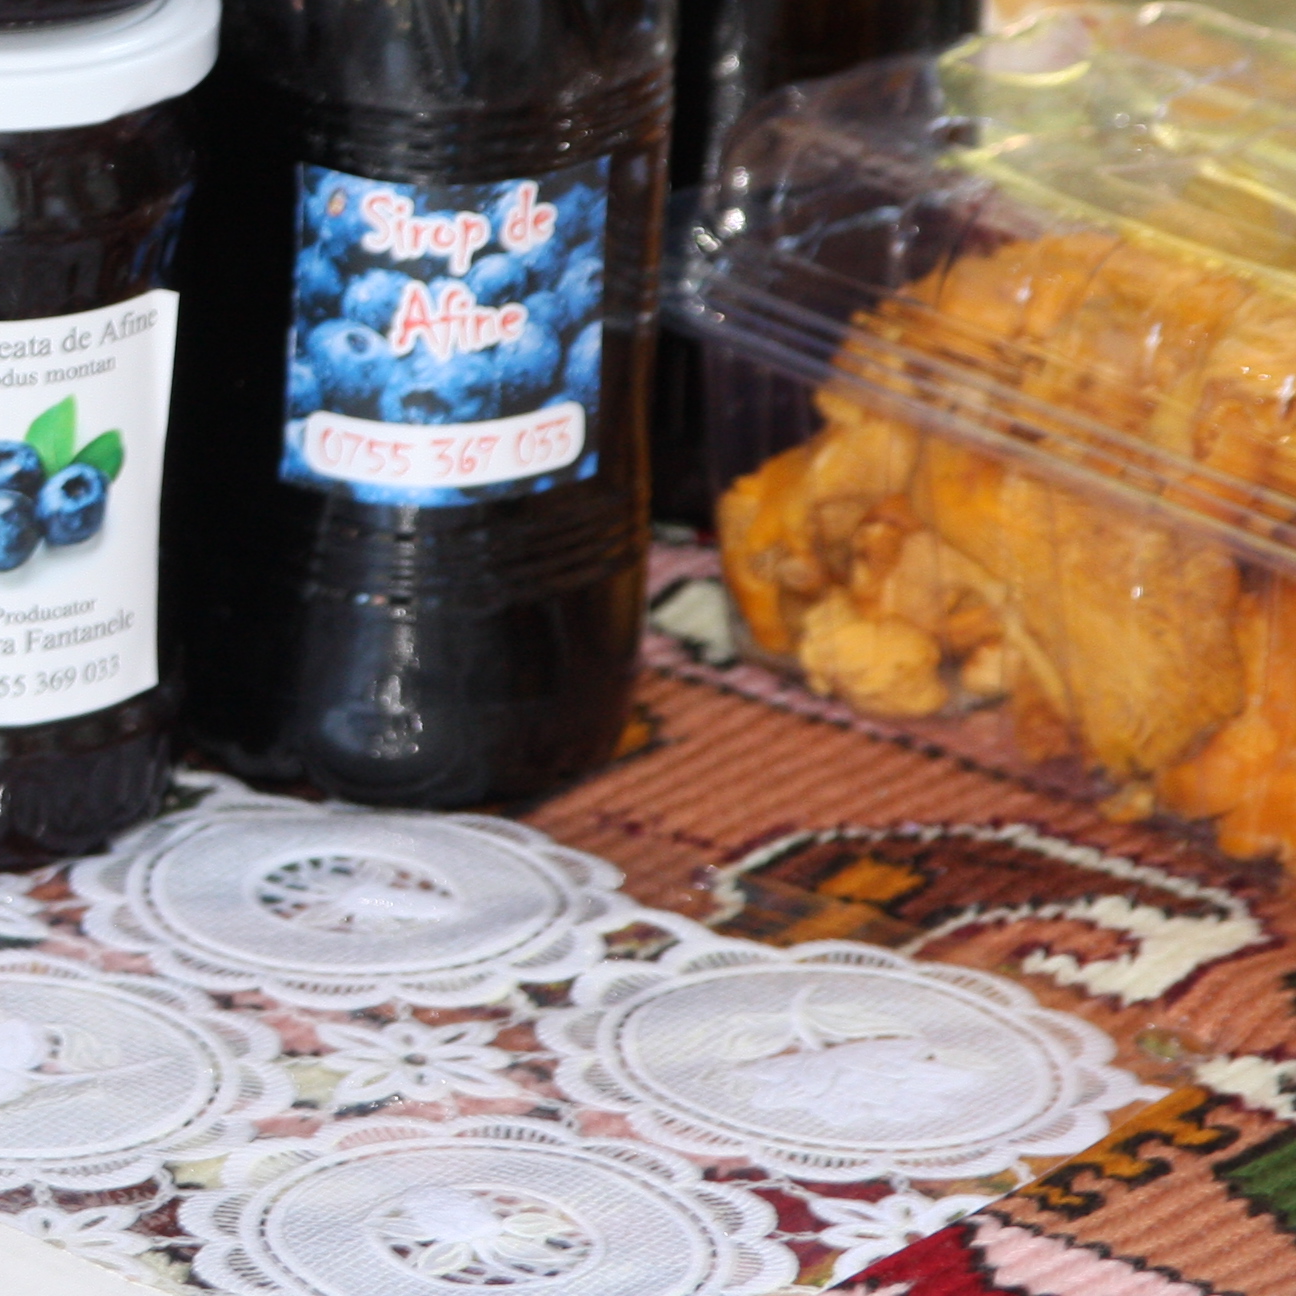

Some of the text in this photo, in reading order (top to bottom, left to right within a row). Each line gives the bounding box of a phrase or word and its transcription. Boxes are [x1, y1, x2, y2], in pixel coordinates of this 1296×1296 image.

[360, 180, 558, 277] Sirop de
[61, 326, 92, 354] de
[99, 305, 159, 346] Afine
[390, 280, 529, 361] Afine
[44, 356, 117, 385] montan
[319, 426, 416, 477] 0755
[515, 415, 573, 467] 033
[24, 608, 135, 654] Fantanele
[35, 668, 76, 694] 369
[82, 655, 121, 684] 033
